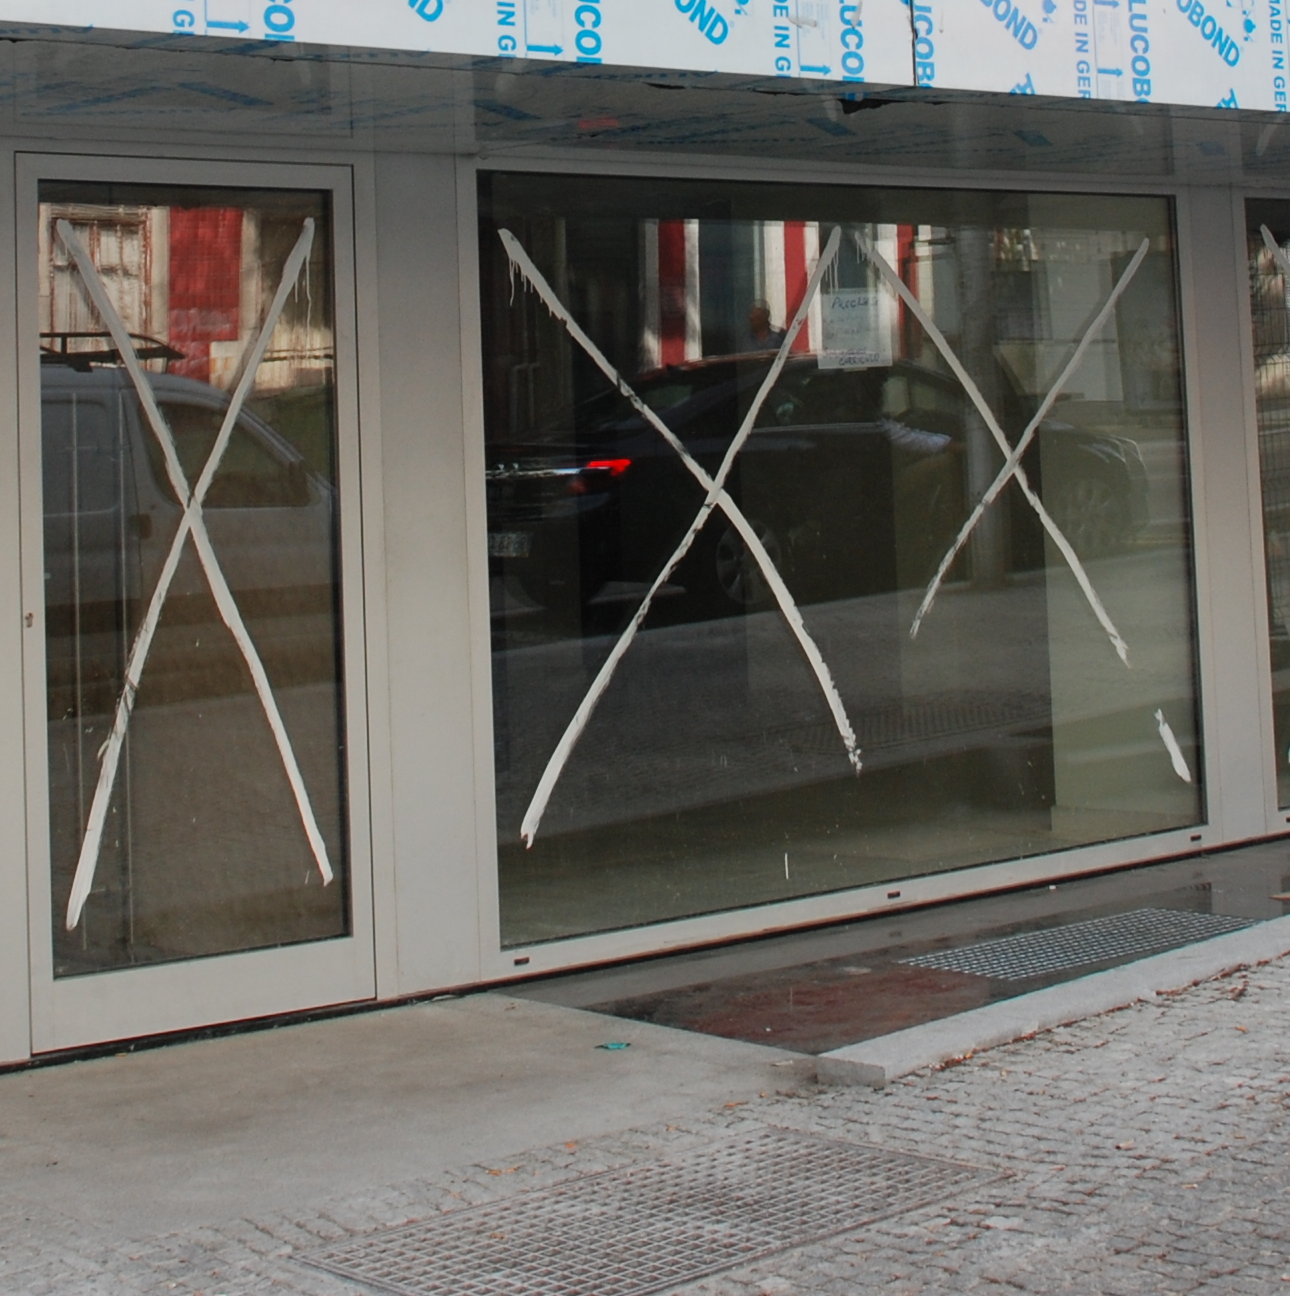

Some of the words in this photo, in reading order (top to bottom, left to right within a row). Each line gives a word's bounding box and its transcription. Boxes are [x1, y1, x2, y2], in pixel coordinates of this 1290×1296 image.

[496, 2, 517, 28] IN
[773, 26, 791, 49] IN
[1075, 33, 1090, 53] IN
[1272, 50, 1285, 70] IN
